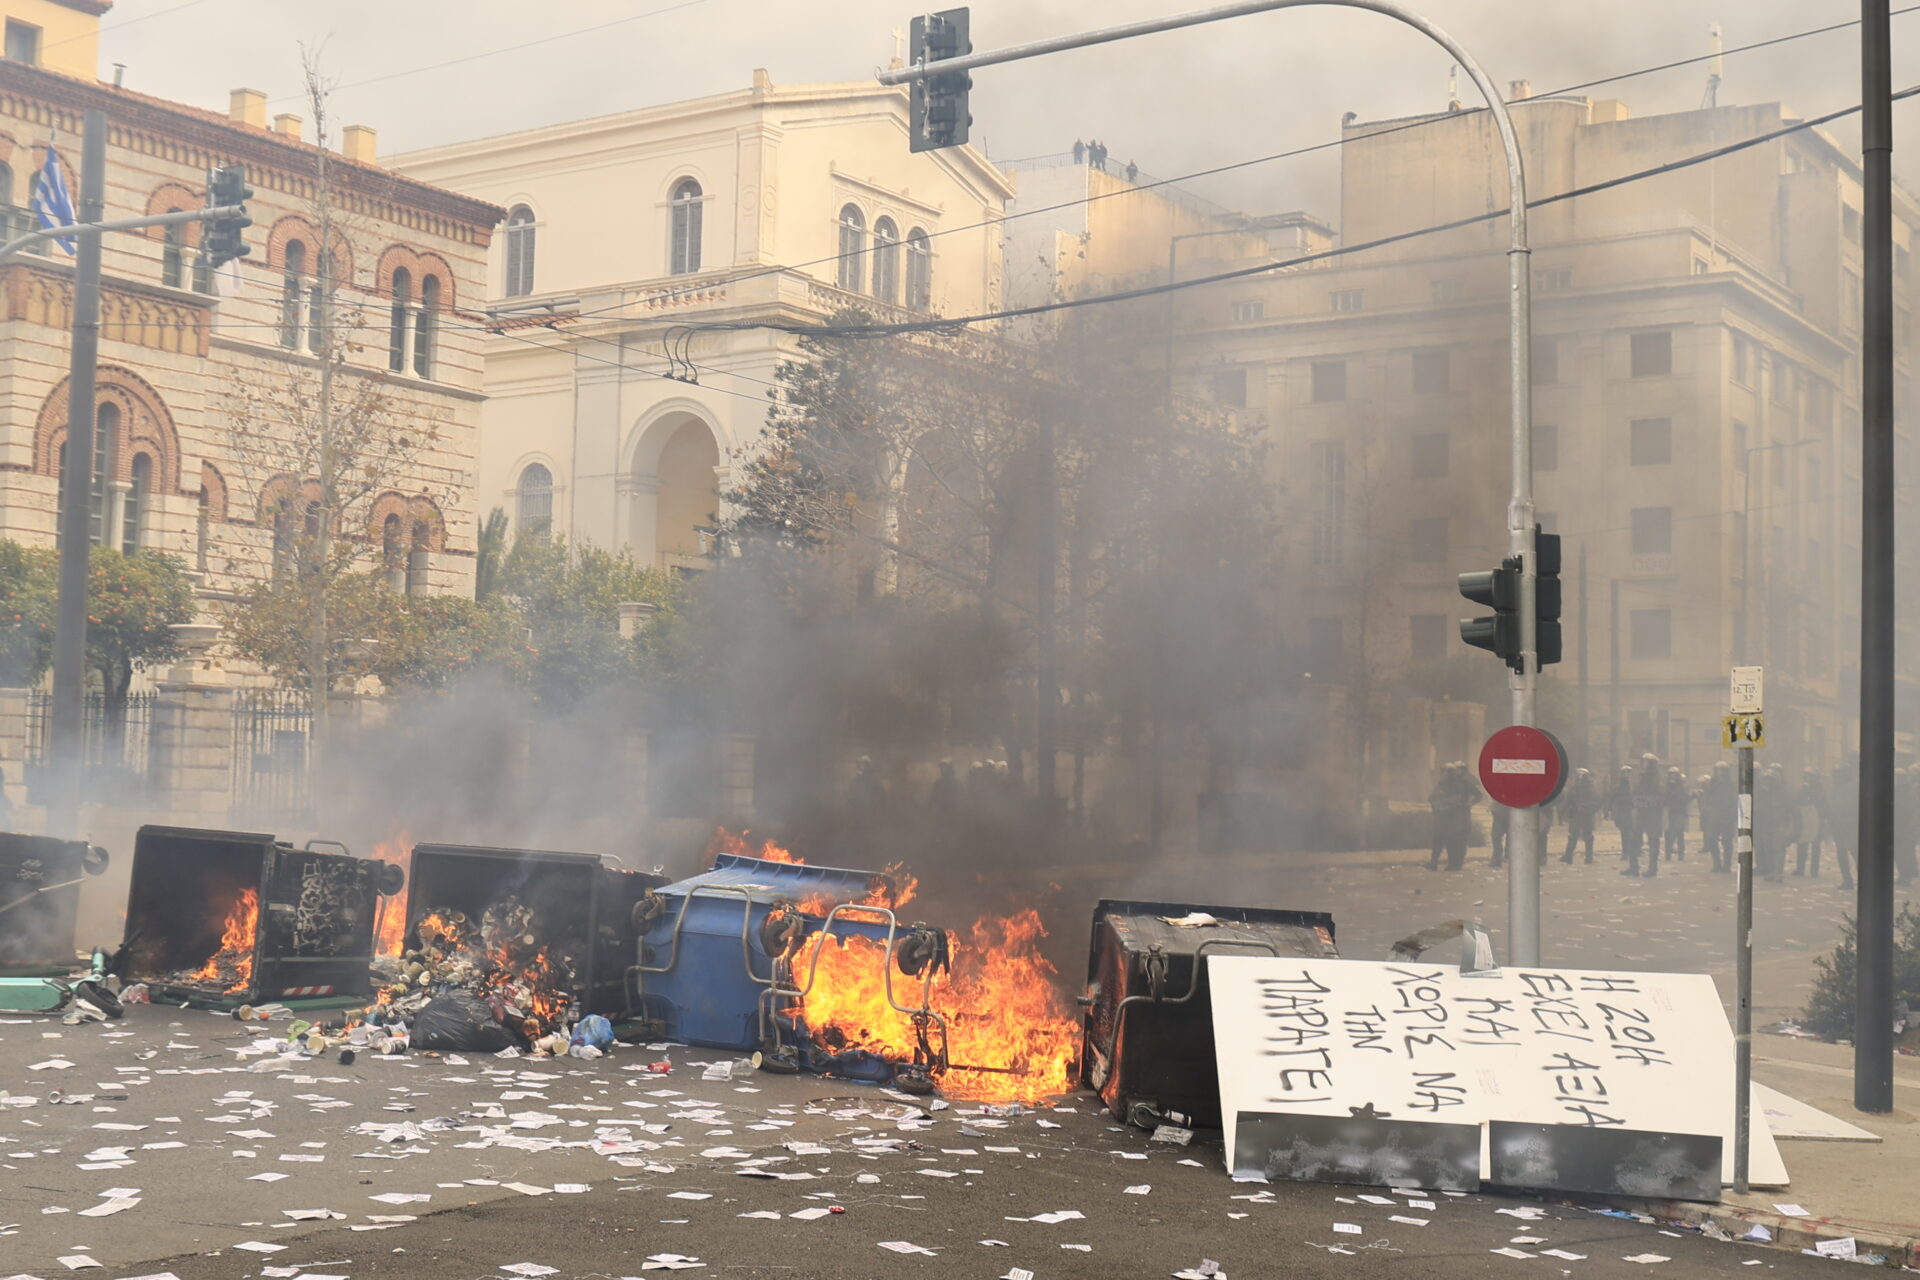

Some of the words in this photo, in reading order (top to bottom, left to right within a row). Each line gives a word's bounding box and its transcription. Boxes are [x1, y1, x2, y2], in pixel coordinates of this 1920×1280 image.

[1519, 973, 1594, 1042] ΕΧΕΙ
[1579, 976, 1641, 993] Η
[1256, 970, 1333, 1102] ΠΑΡΑΓΕΙ
[1343, 1004, 1392, 1053] ΤΗΝ
[1455, 997, 1522, 1046] ΚΑΙ
[1407, 1072, 1468, 1112] ΝΑ
[1541, 1052, 1626, 1127] ΑΞΙΑ
